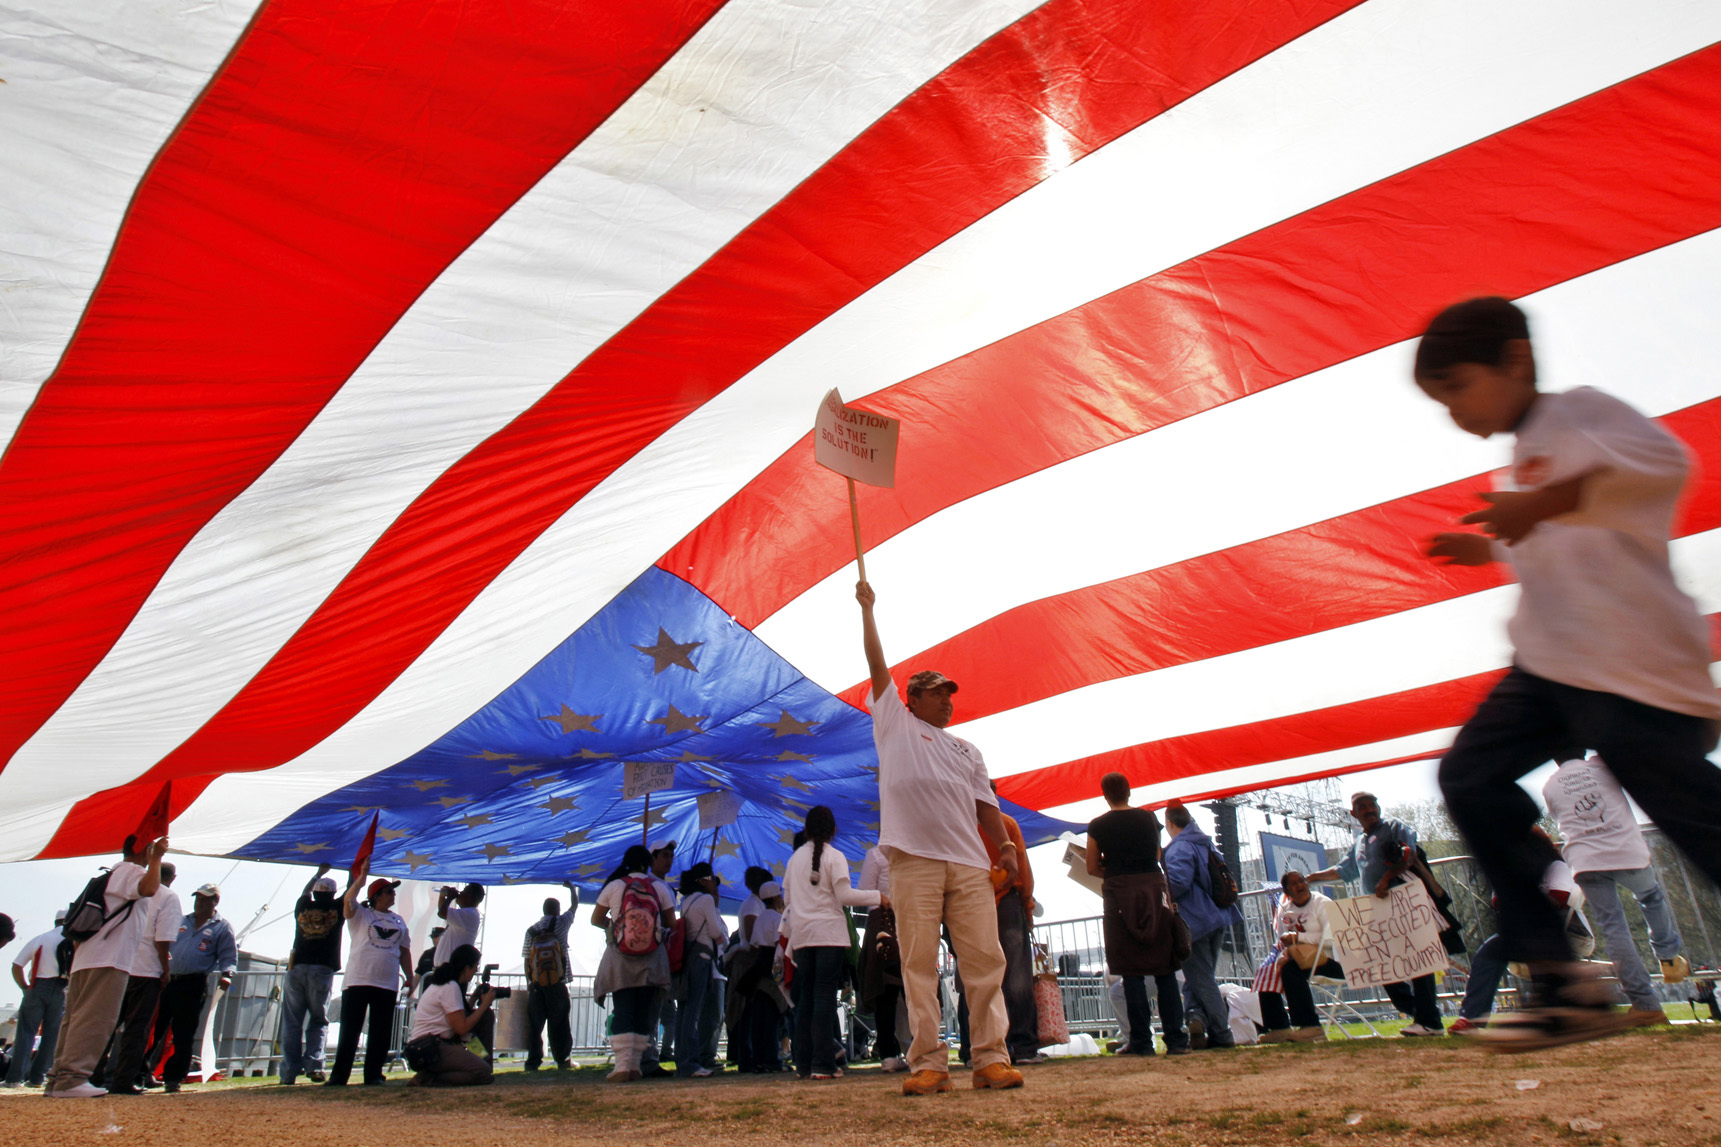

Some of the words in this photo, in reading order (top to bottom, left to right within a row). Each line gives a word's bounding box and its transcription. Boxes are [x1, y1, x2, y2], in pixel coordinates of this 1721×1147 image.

[834, 422, 844, 435] IS
[846, 427, 867, 444] THE
[650, 764, 674, 777] CAUSES
[1557, 768, 1591, 783] Dignidad
[1335, 896, 1375, 926] WE
[1390, 883, 1421, 917] ARE
[1334, 904, 1431, 956] PERSECUTED
[1347, 962, 1393, 986] FREE
[1392, 940, 1446, 979] COUNTRY
[1363, 937, 1391, 964] IN
[1404, 935, 1417, 953] A
